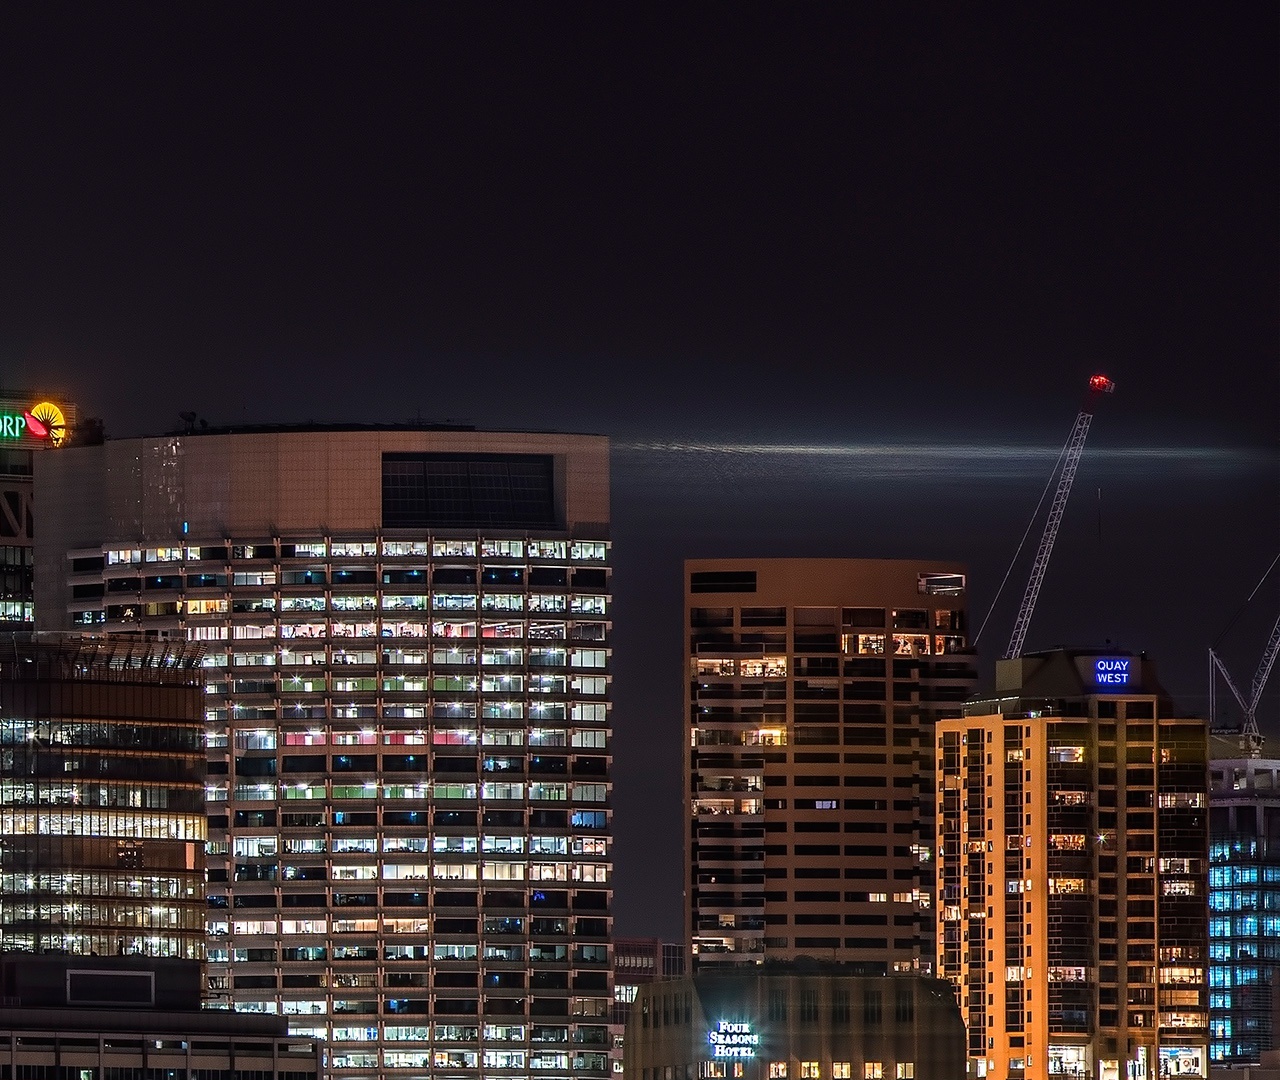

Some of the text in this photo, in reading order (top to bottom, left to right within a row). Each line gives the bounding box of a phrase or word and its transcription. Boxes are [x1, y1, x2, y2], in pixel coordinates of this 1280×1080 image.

[1097, 660, 1129, 671] QUAY
[1097, 673, 1129, 683] WEST
[718, 1021, 751, 1034] FOUR
[709, 1031, 759, 1045] SEASONS
[714, 1044, 755, 1057] HOTEL
